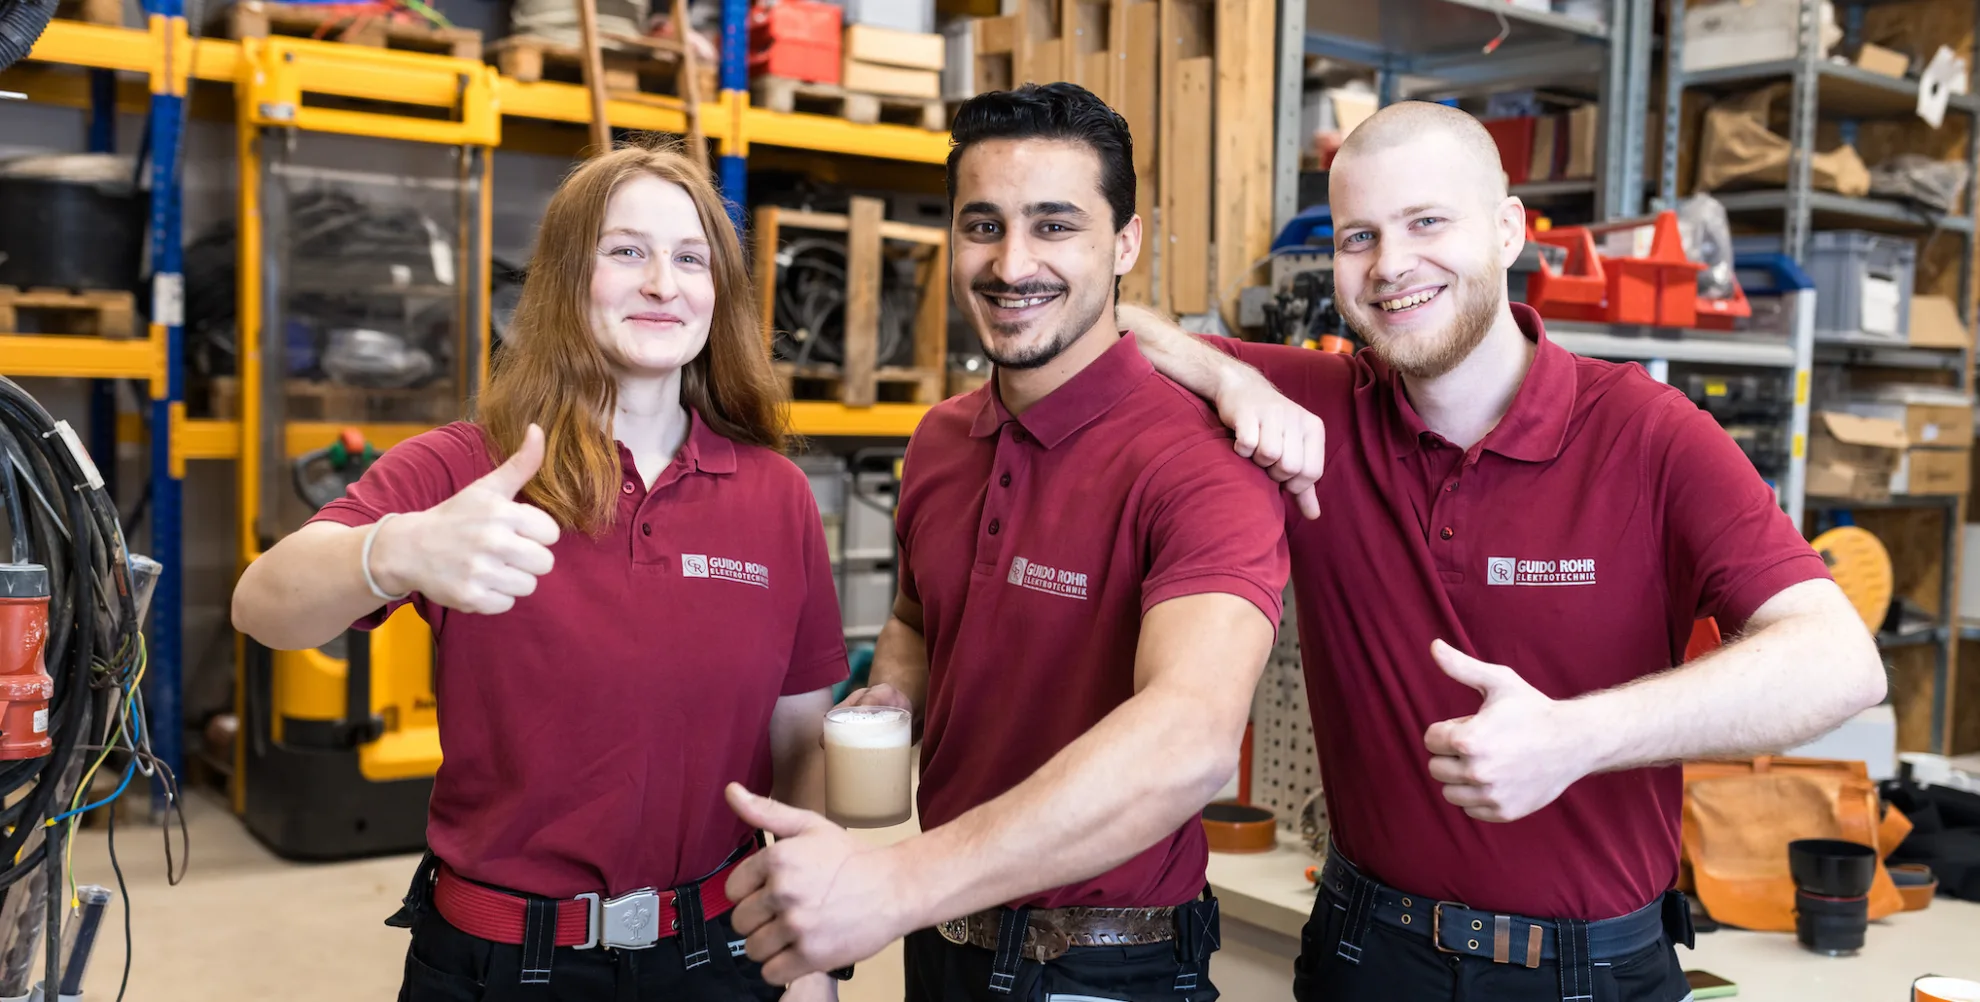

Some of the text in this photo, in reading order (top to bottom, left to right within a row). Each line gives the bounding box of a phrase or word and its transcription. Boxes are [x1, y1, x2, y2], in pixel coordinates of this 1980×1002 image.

[709, 557, 742, 571] GUIDO
[1517, 559, 1595, 573] GUIDO ROHR
[1026, 563, 1087, 587] GUIDO ROHR
[1516, 573, 1595, 581] ELEKTROTECHNIK
[1024, 575, 1087, 595] ELEKTROTECHNIK
